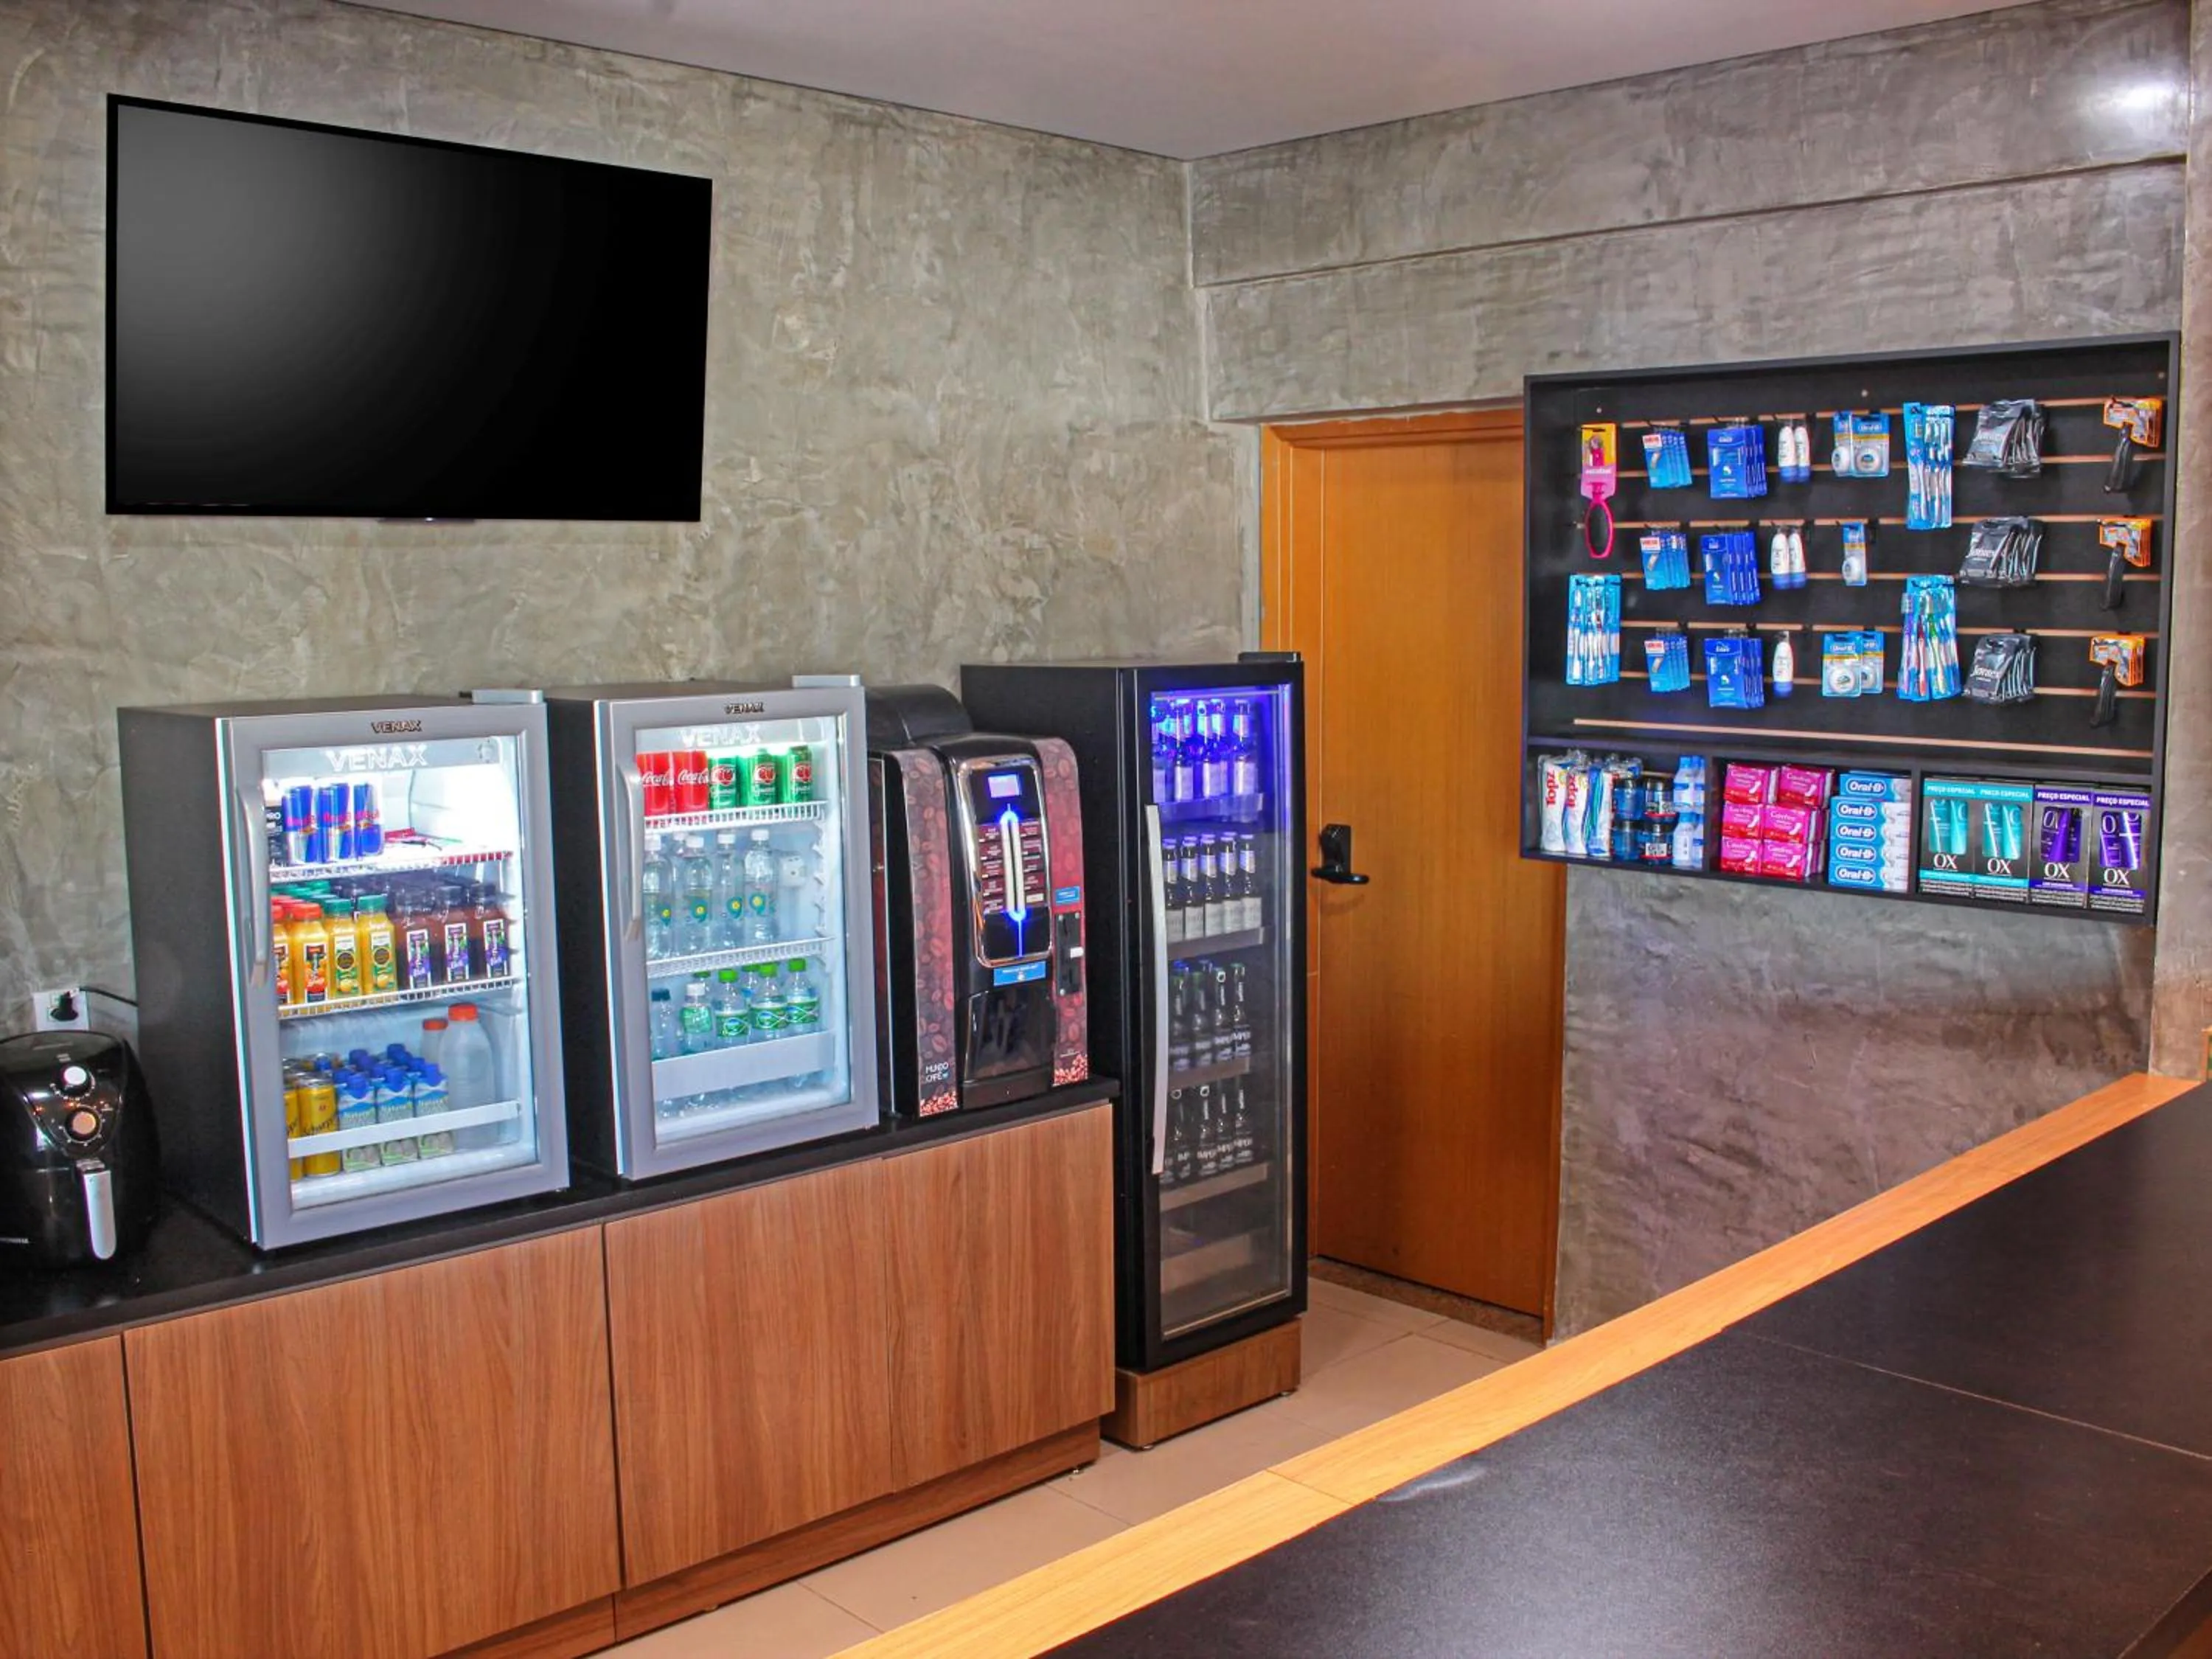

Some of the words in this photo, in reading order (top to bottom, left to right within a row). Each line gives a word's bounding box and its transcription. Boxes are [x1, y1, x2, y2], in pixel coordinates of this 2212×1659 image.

[725, 703, 765, 714] VENAX
[371, 720, 422, 734] VENAX
[680, 723, 762, 747] VENAX
[324, 744, 428, 772] VENAX
[2037, 792, 2059, 801] PREÇO
[2059, 793, 2090, 801] ESPECIAL
[2096, 796, 2118, 806] PREÇO
[2118, 799, 2149, 807] ESPECIAL
[1933, 853, 1958, 869] OX
[1987, 858, 2011, 874] OX
[2044, 862, 2070, 879] OX
[2104, 868, 2130, 885] OX
